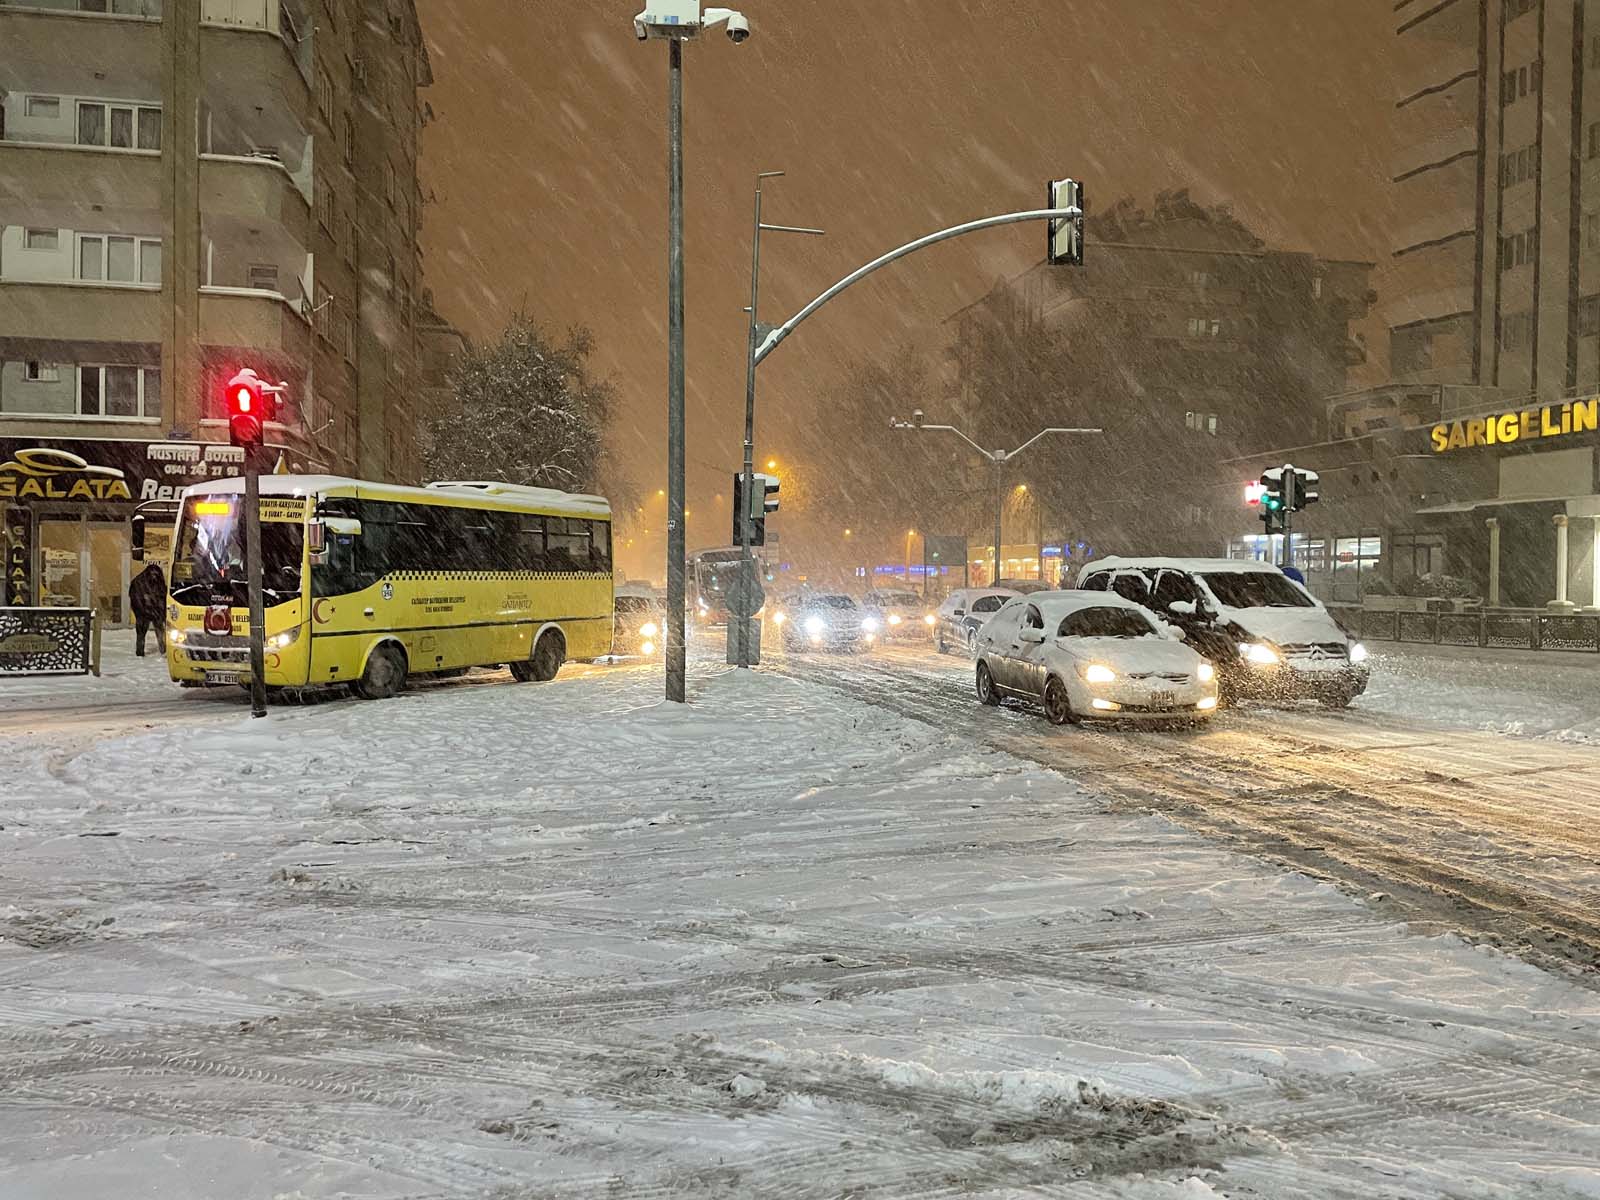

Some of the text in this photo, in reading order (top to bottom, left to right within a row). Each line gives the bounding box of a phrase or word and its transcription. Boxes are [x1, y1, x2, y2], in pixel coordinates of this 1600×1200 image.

[147, 446, 201, 461] MUSTAFA
[211, 466, 222, 476] 27
[0, 476, 132, 499] GALATA
[12, 525, 25, 605] GALATA
